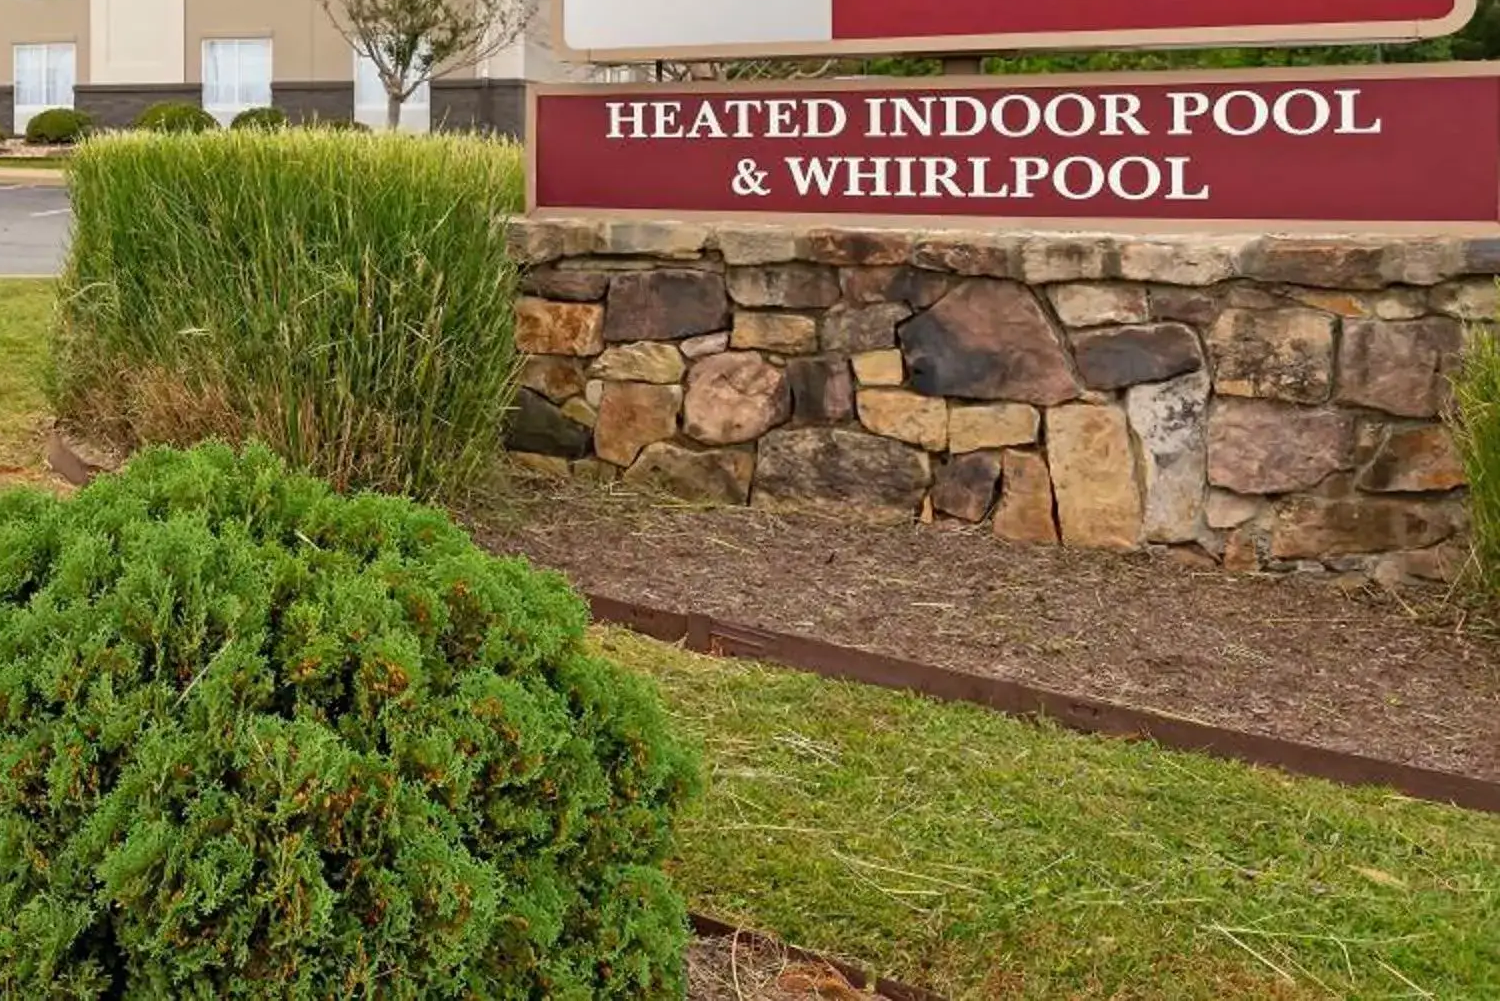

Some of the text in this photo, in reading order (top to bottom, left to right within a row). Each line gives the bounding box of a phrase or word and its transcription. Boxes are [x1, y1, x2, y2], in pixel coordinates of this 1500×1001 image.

[605, 88, 1382, 139] HEATED INDOOR POOL
[731, 156, 1210, 201] & WHIRLPOOL
